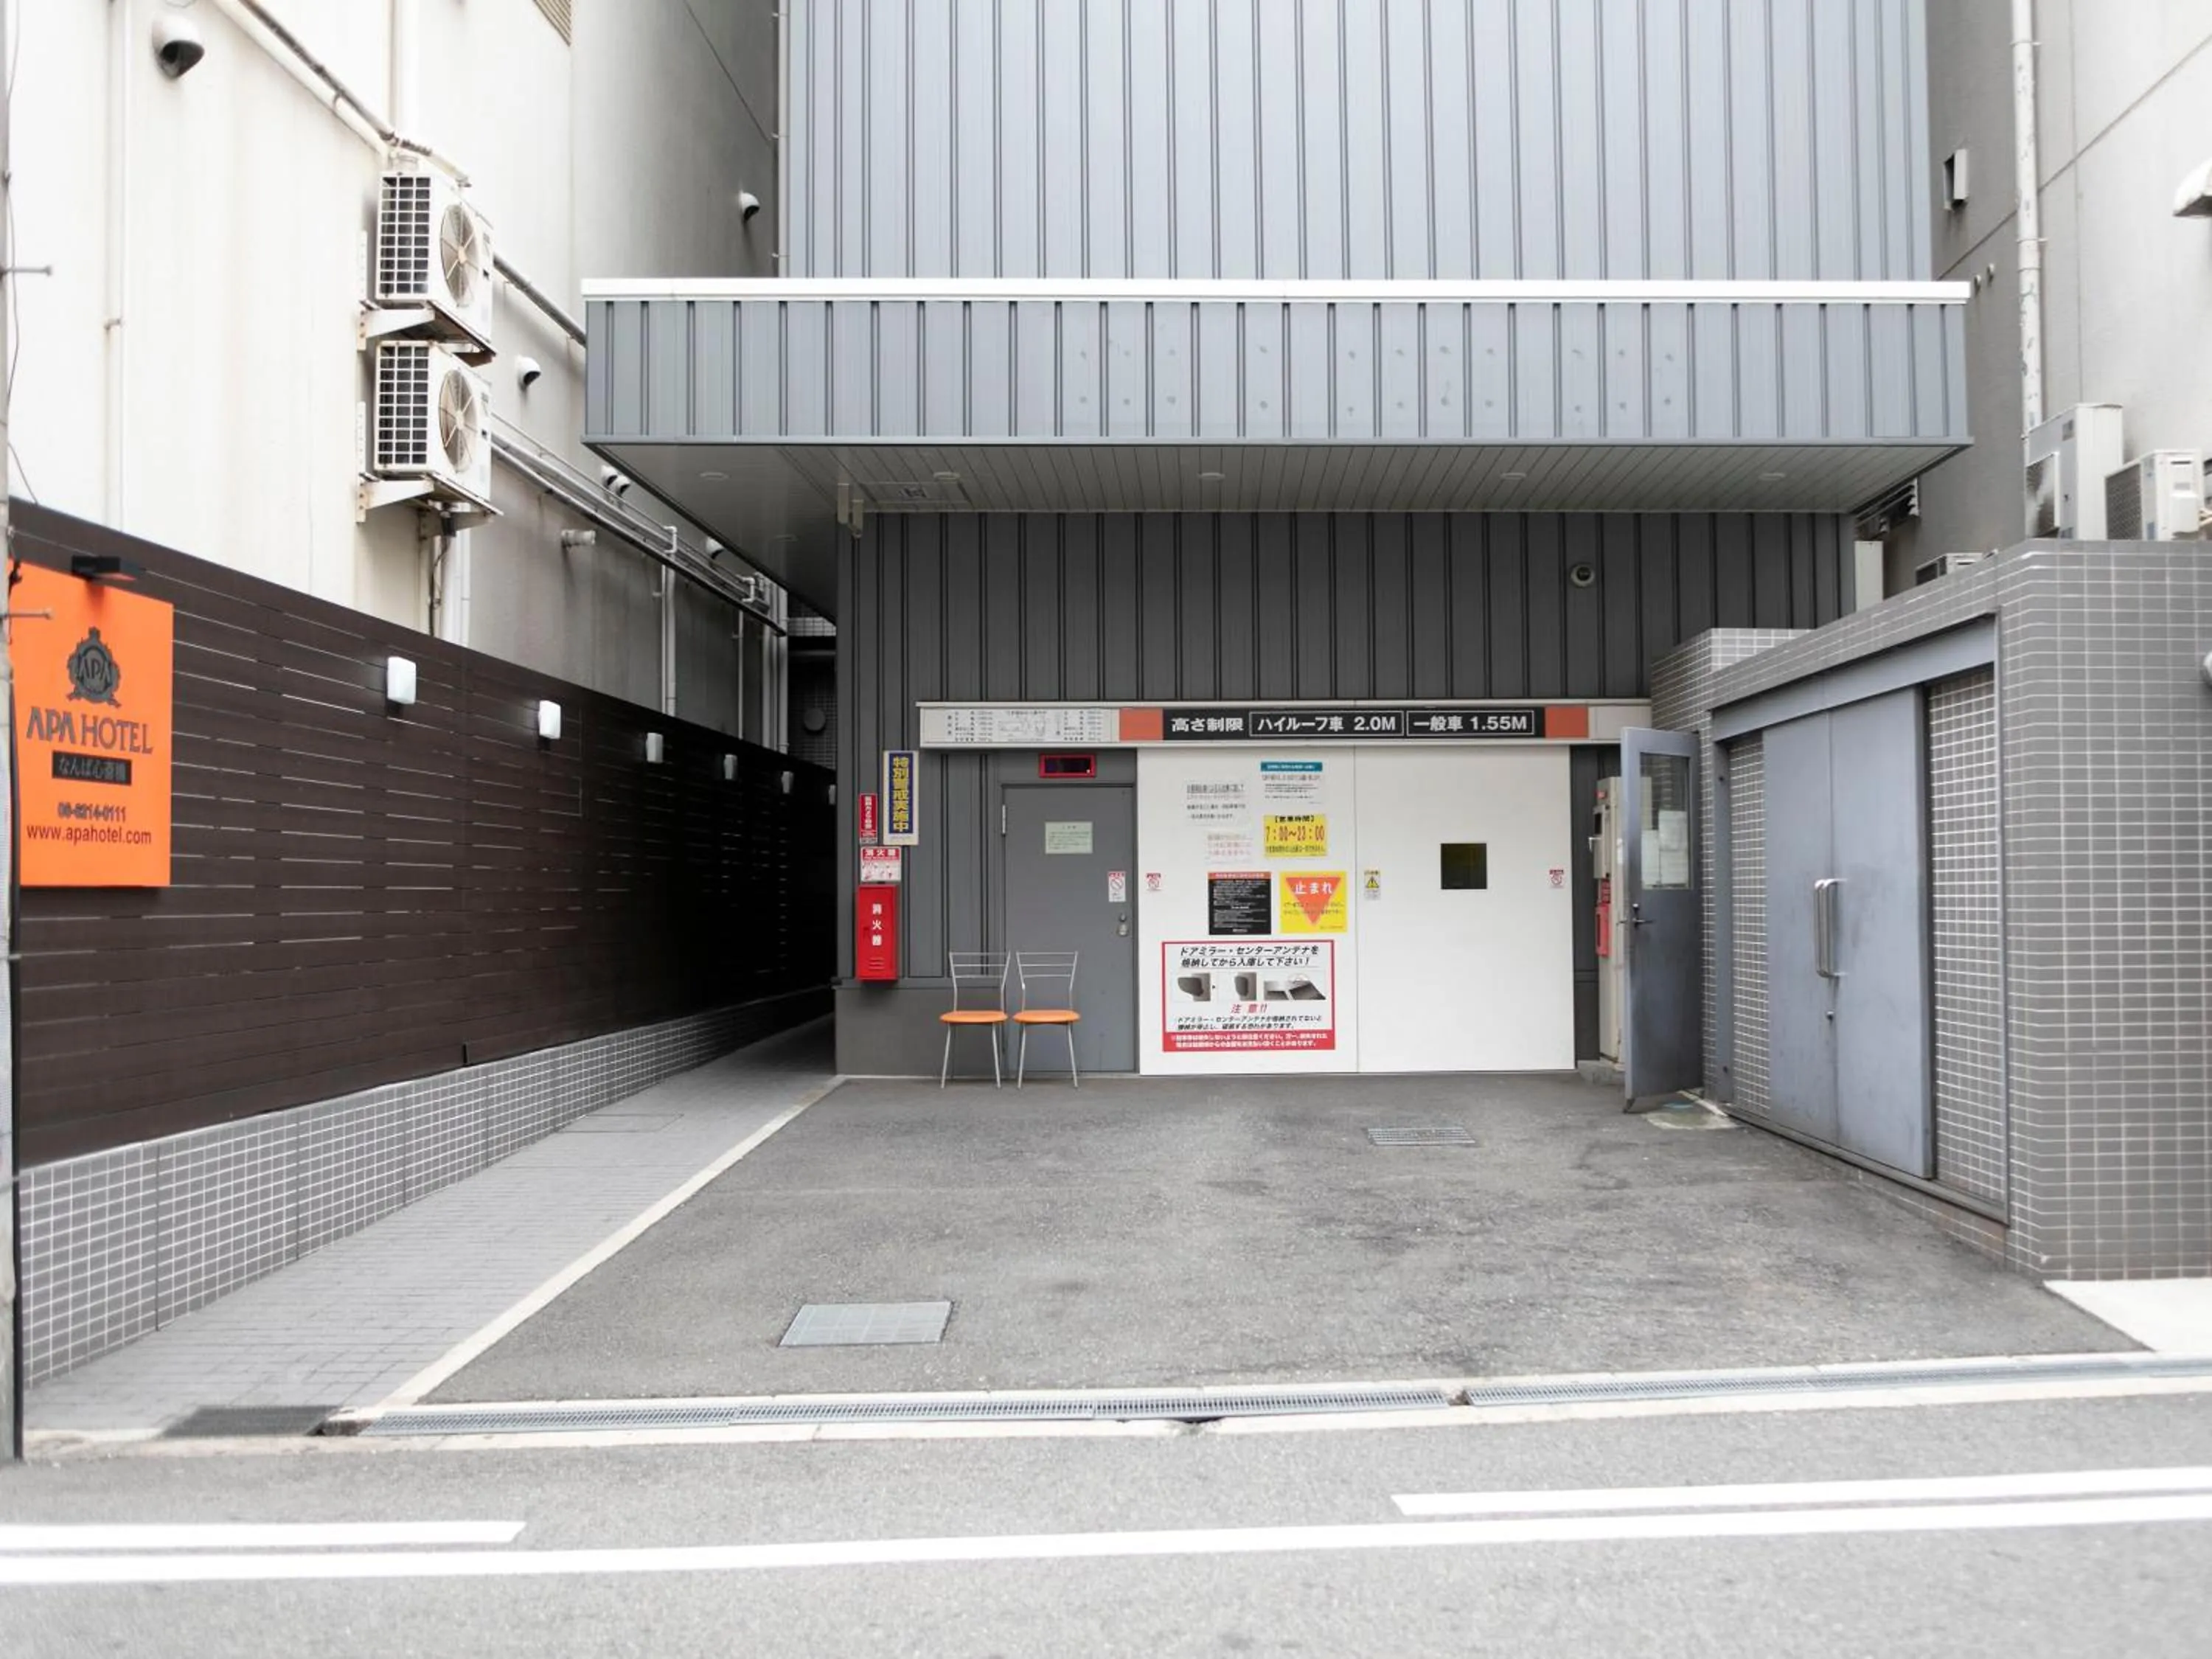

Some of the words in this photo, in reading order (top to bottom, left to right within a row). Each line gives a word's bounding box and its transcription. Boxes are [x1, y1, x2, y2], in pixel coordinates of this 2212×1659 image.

[27, 706, 77, 745] APA
[81, 714, 153, 754] HOTEL
[1172, 717, 1243, 732] 高さ制限
[1257, 716, 1343, 731] ハイルーフ車
[1354, 717, 1396, 731] 2.0M
[1413, 715, 1464, 731] 一般車
[1470, 716, 1528, 731] 1.55M
[27, 824, 152, 846] www.apahotel.com
[1295, 880, 1332, 894] 止まれ
